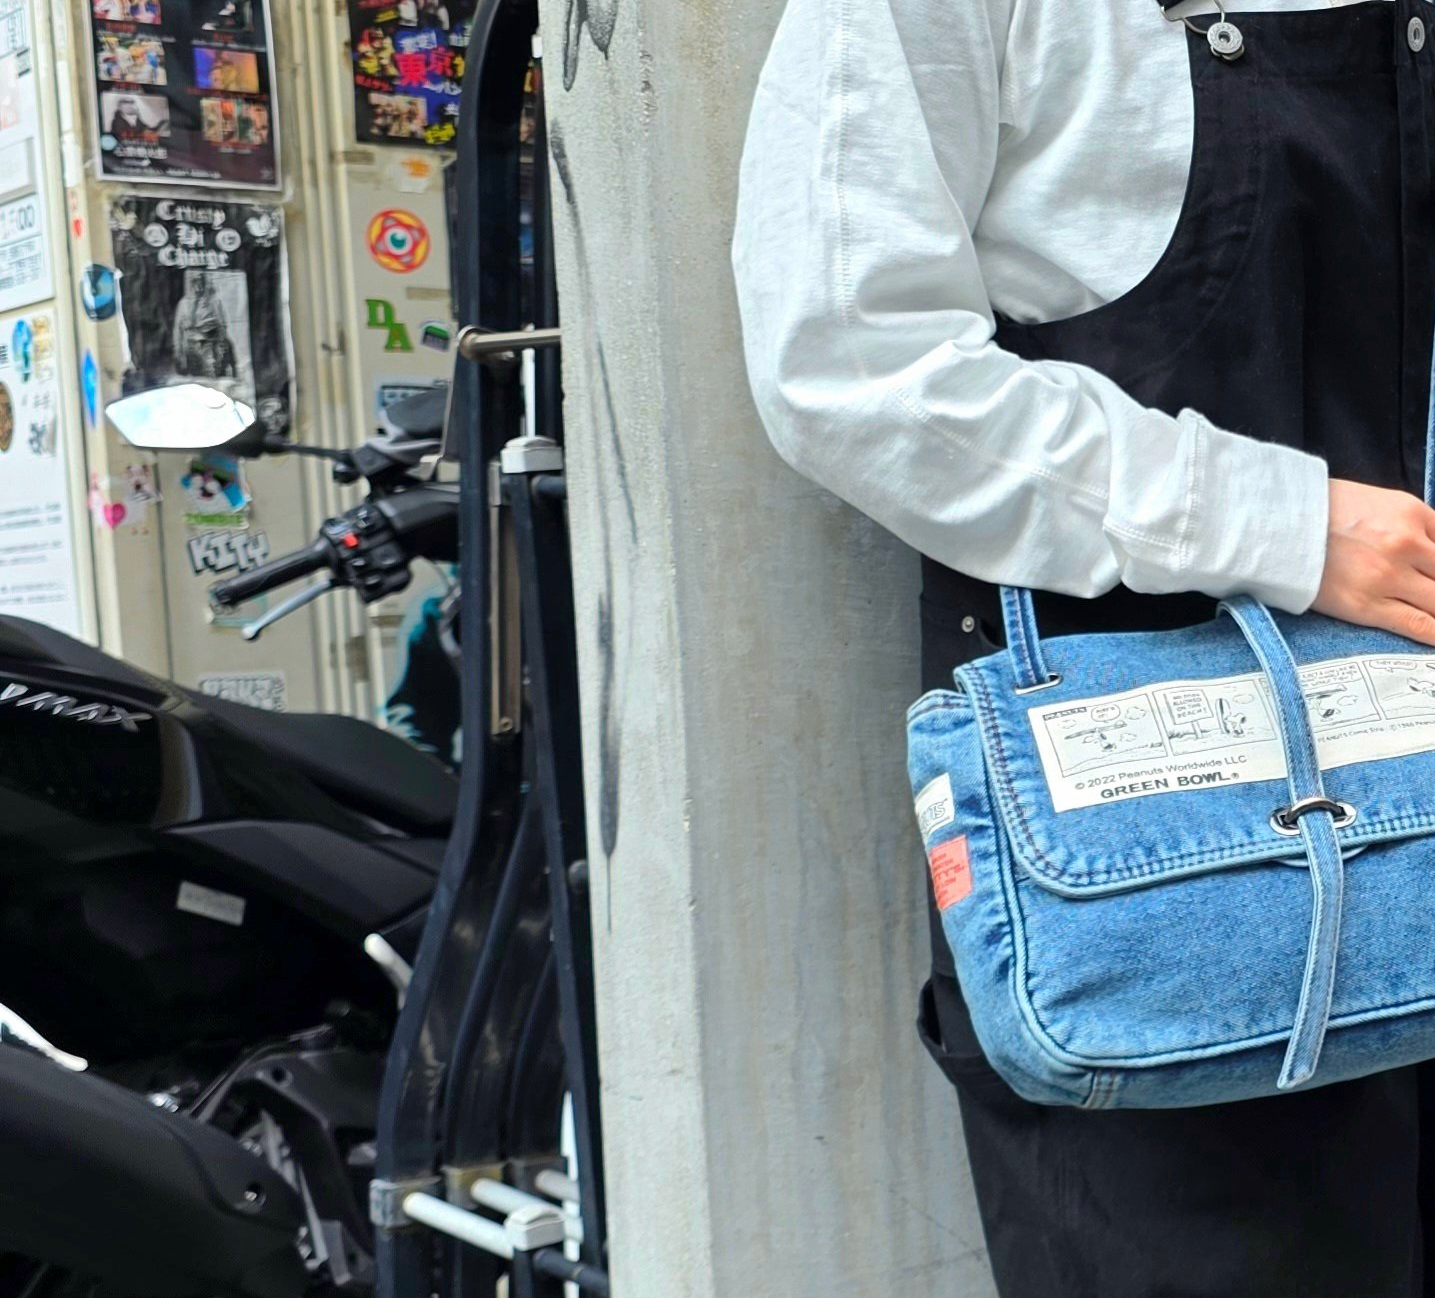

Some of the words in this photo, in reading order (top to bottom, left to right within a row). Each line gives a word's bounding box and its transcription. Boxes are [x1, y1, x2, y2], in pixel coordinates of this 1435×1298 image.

[1087, 775, 1116, 788] 2022
[1119, 766, 1164, 781] Peanuts
[1165, 758, 1223, 774] Worldwide
[1224, 755, 1248, 766] LLC
[1101, 778, 1169, 800] GREEN
